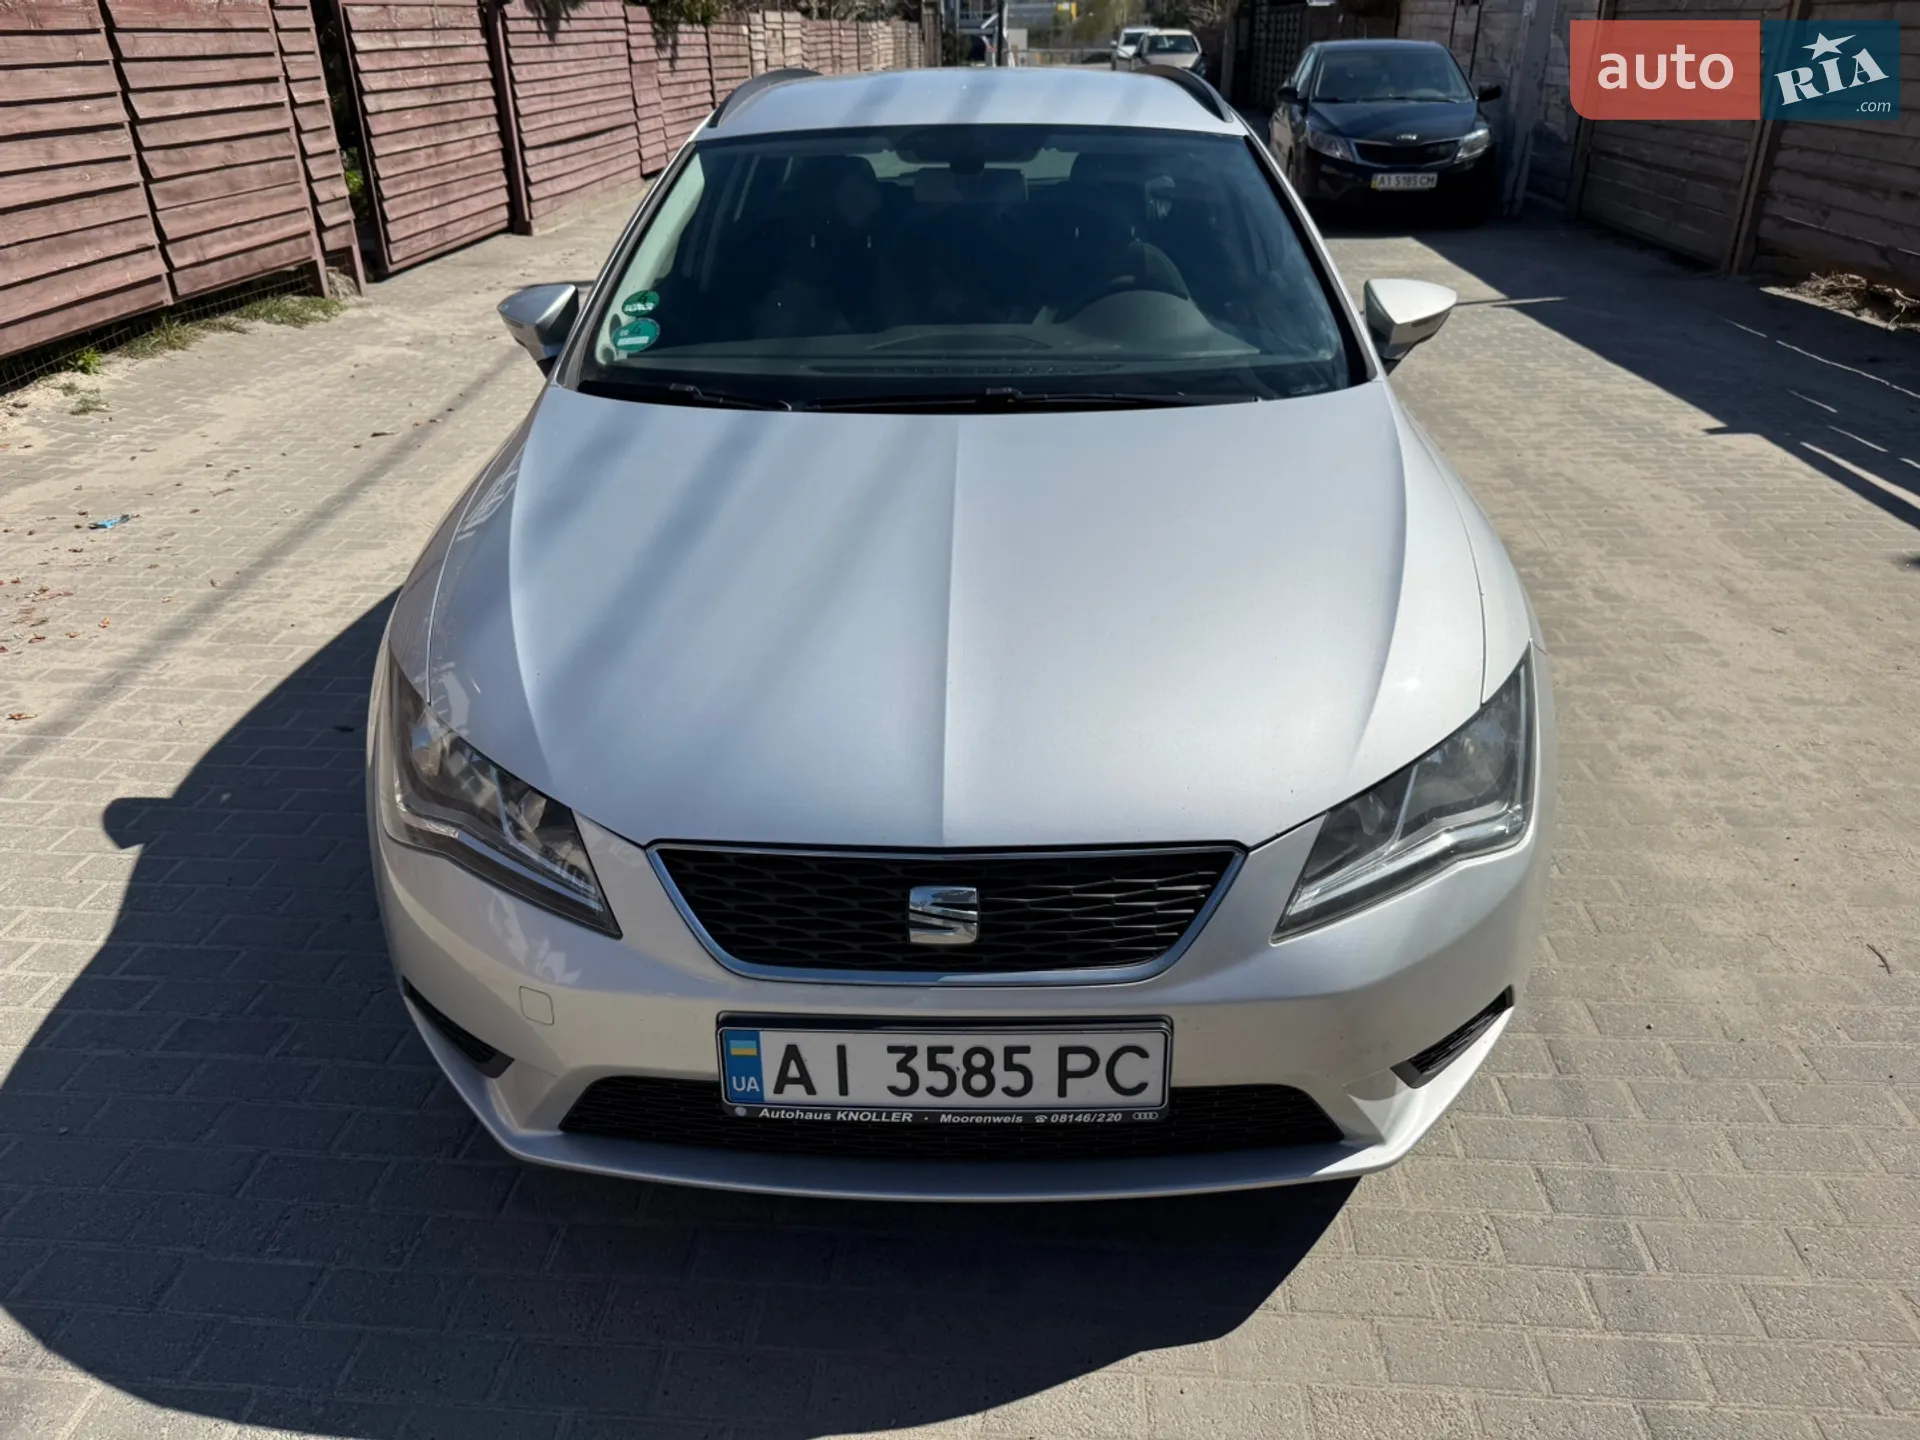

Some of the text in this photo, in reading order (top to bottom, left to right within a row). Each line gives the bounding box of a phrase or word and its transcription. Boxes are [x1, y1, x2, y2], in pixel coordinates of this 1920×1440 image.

[773, 1043, 1150, 1098] AI 3585 PC
[731, 1076, 761, 1092] UA
[758, 1107, 1123, 1124] Autohaus KNOLLER Moorenweis 08146/220
